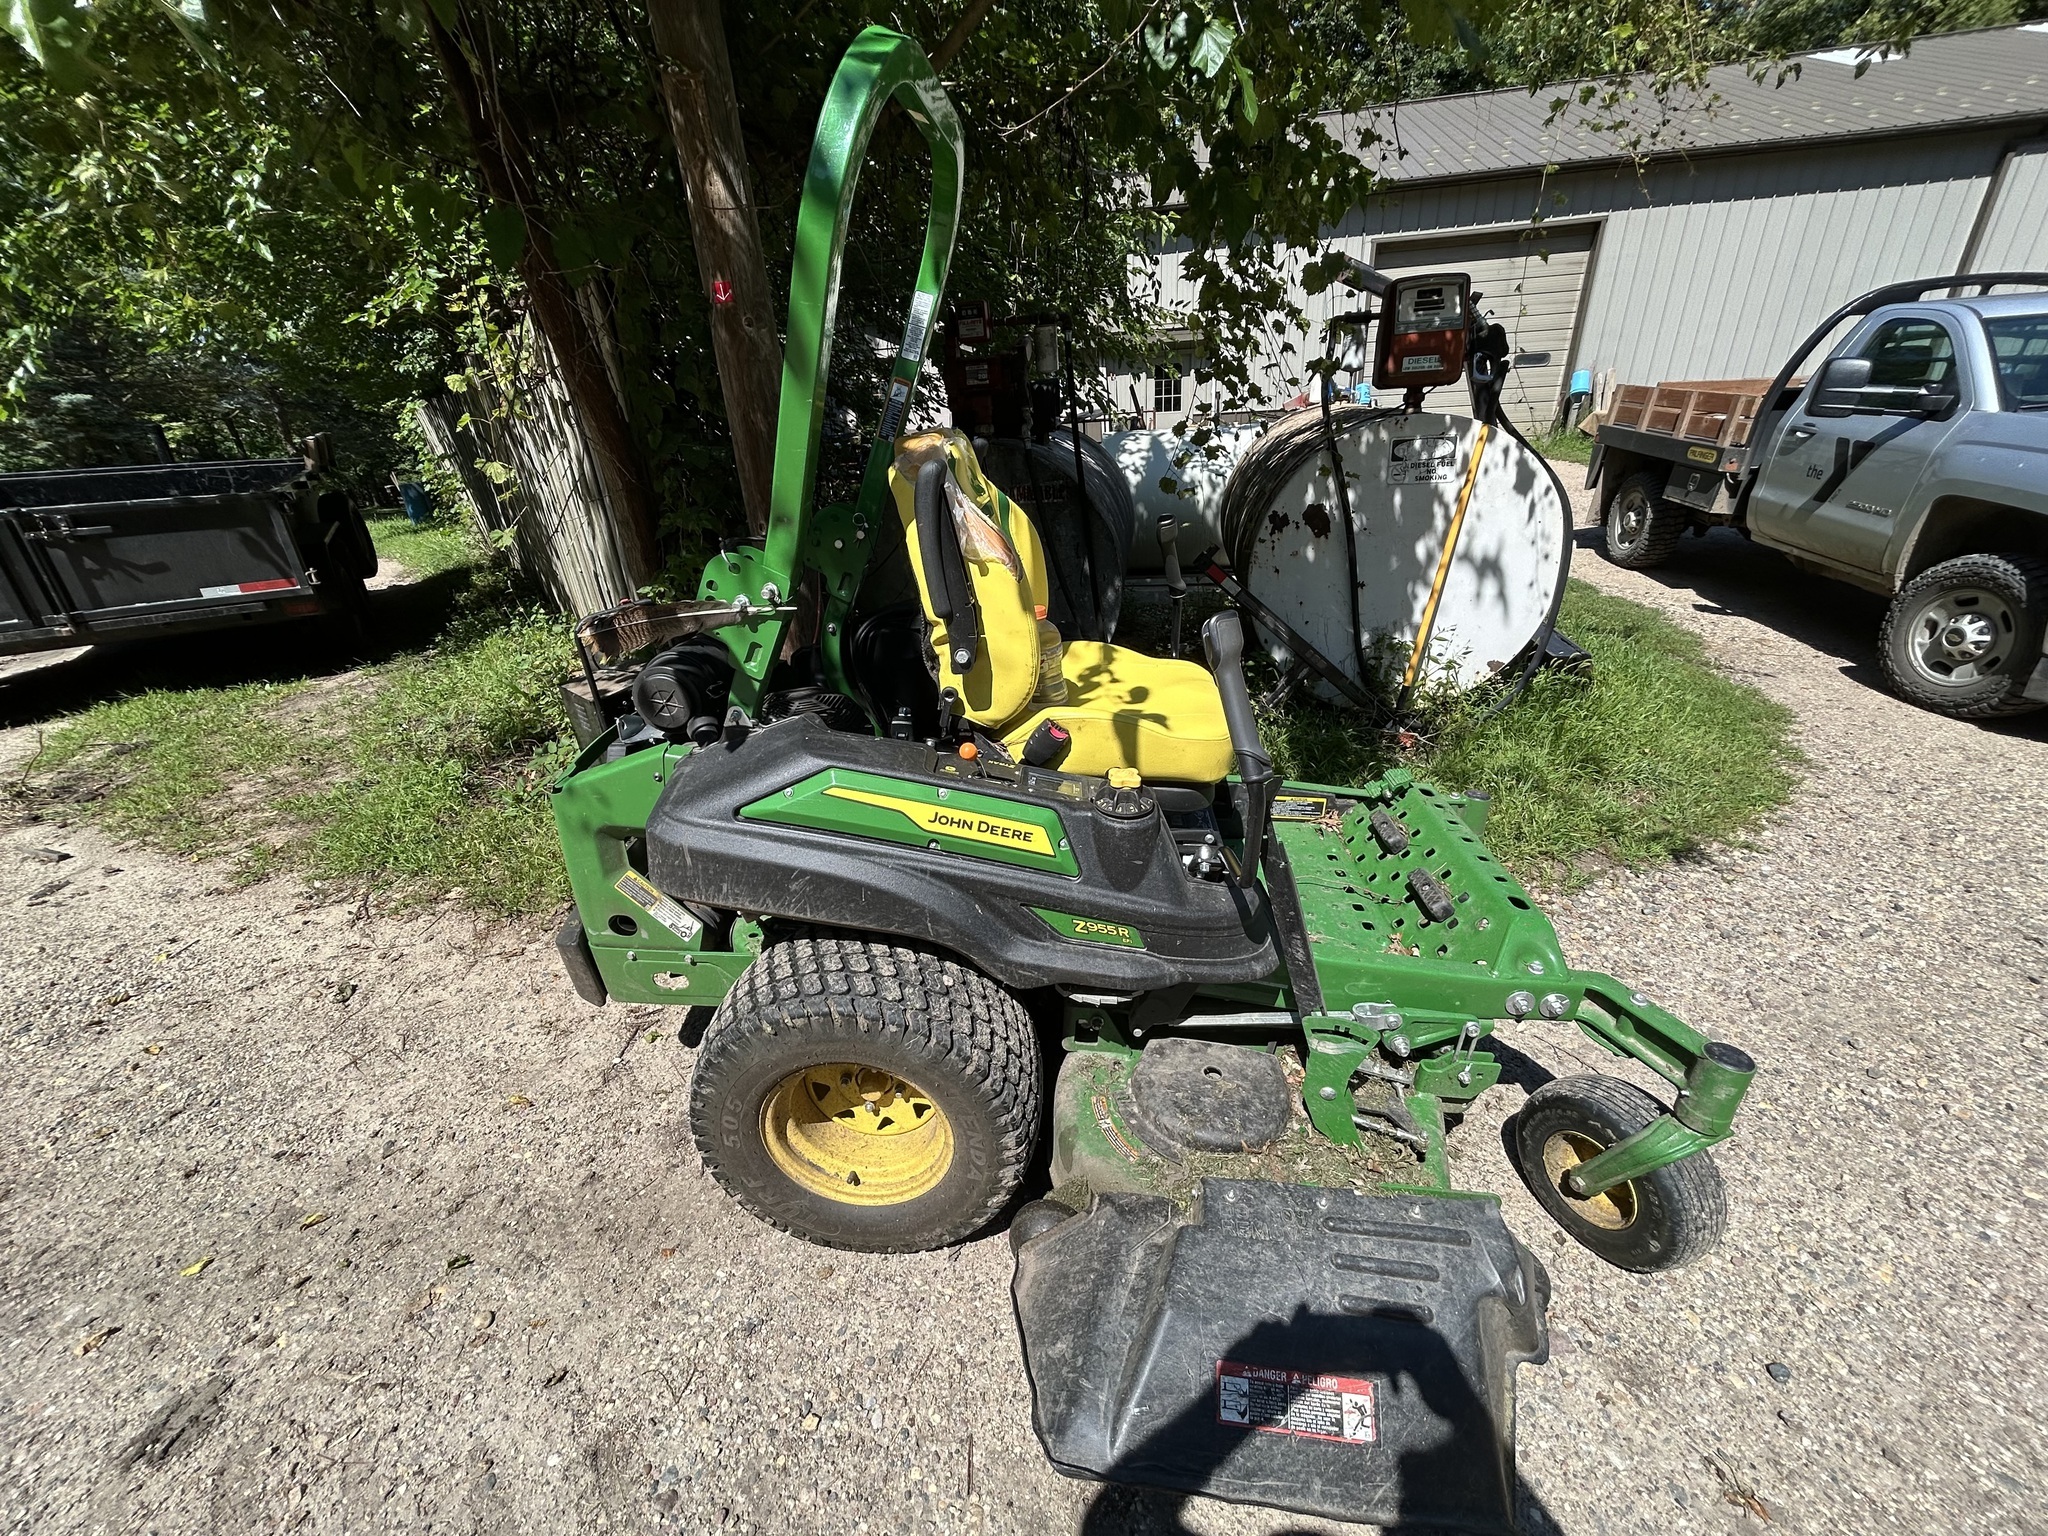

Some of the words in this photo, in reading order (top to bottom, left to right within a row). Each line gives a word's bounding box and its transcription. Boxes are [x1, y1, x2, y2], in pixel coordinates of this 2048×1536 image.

[1407, 356, 1441, 365] DIESEL
[1414, 474, 1448, 482] SMOKING
[1806, 464, 1824, 480] the
[928, 811, 974, 831] JOHN
[977, 821, 1034, 842] DEERE
[1072, 919, 1130, 938] Z955R
[723, 1096, 743, 1150] 505
[1252, 1367, 1287, 1383] DANGER
[1301, 1374, 1338, 1390] PELIGRO
